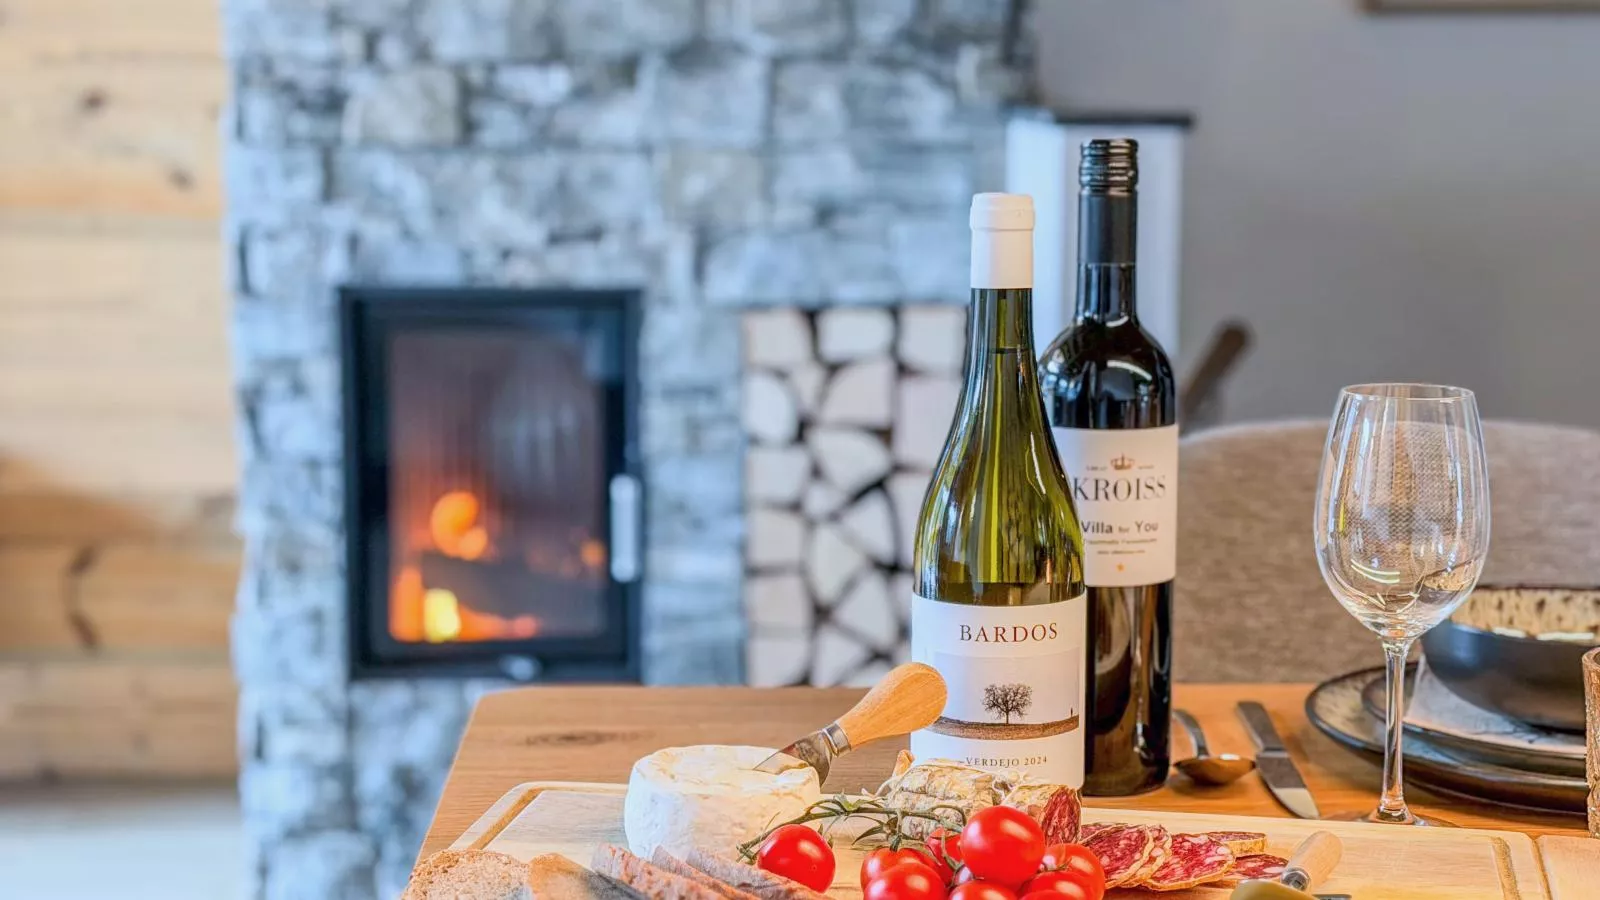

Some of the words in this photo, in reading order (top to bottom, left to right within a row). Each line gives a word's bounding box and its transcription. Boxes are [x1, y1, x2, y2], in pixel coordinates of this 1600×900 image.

[1074, 476, 1166, 502] KROISS
[1081, 521, 1113, 534] Villa
[1135, 520, 1159, 533] You
[959, 622, 1058, 643] BARDOS
[966, 757, 1020, 768] VERDEJO
[1024, 755, 1047, 766] 2024
